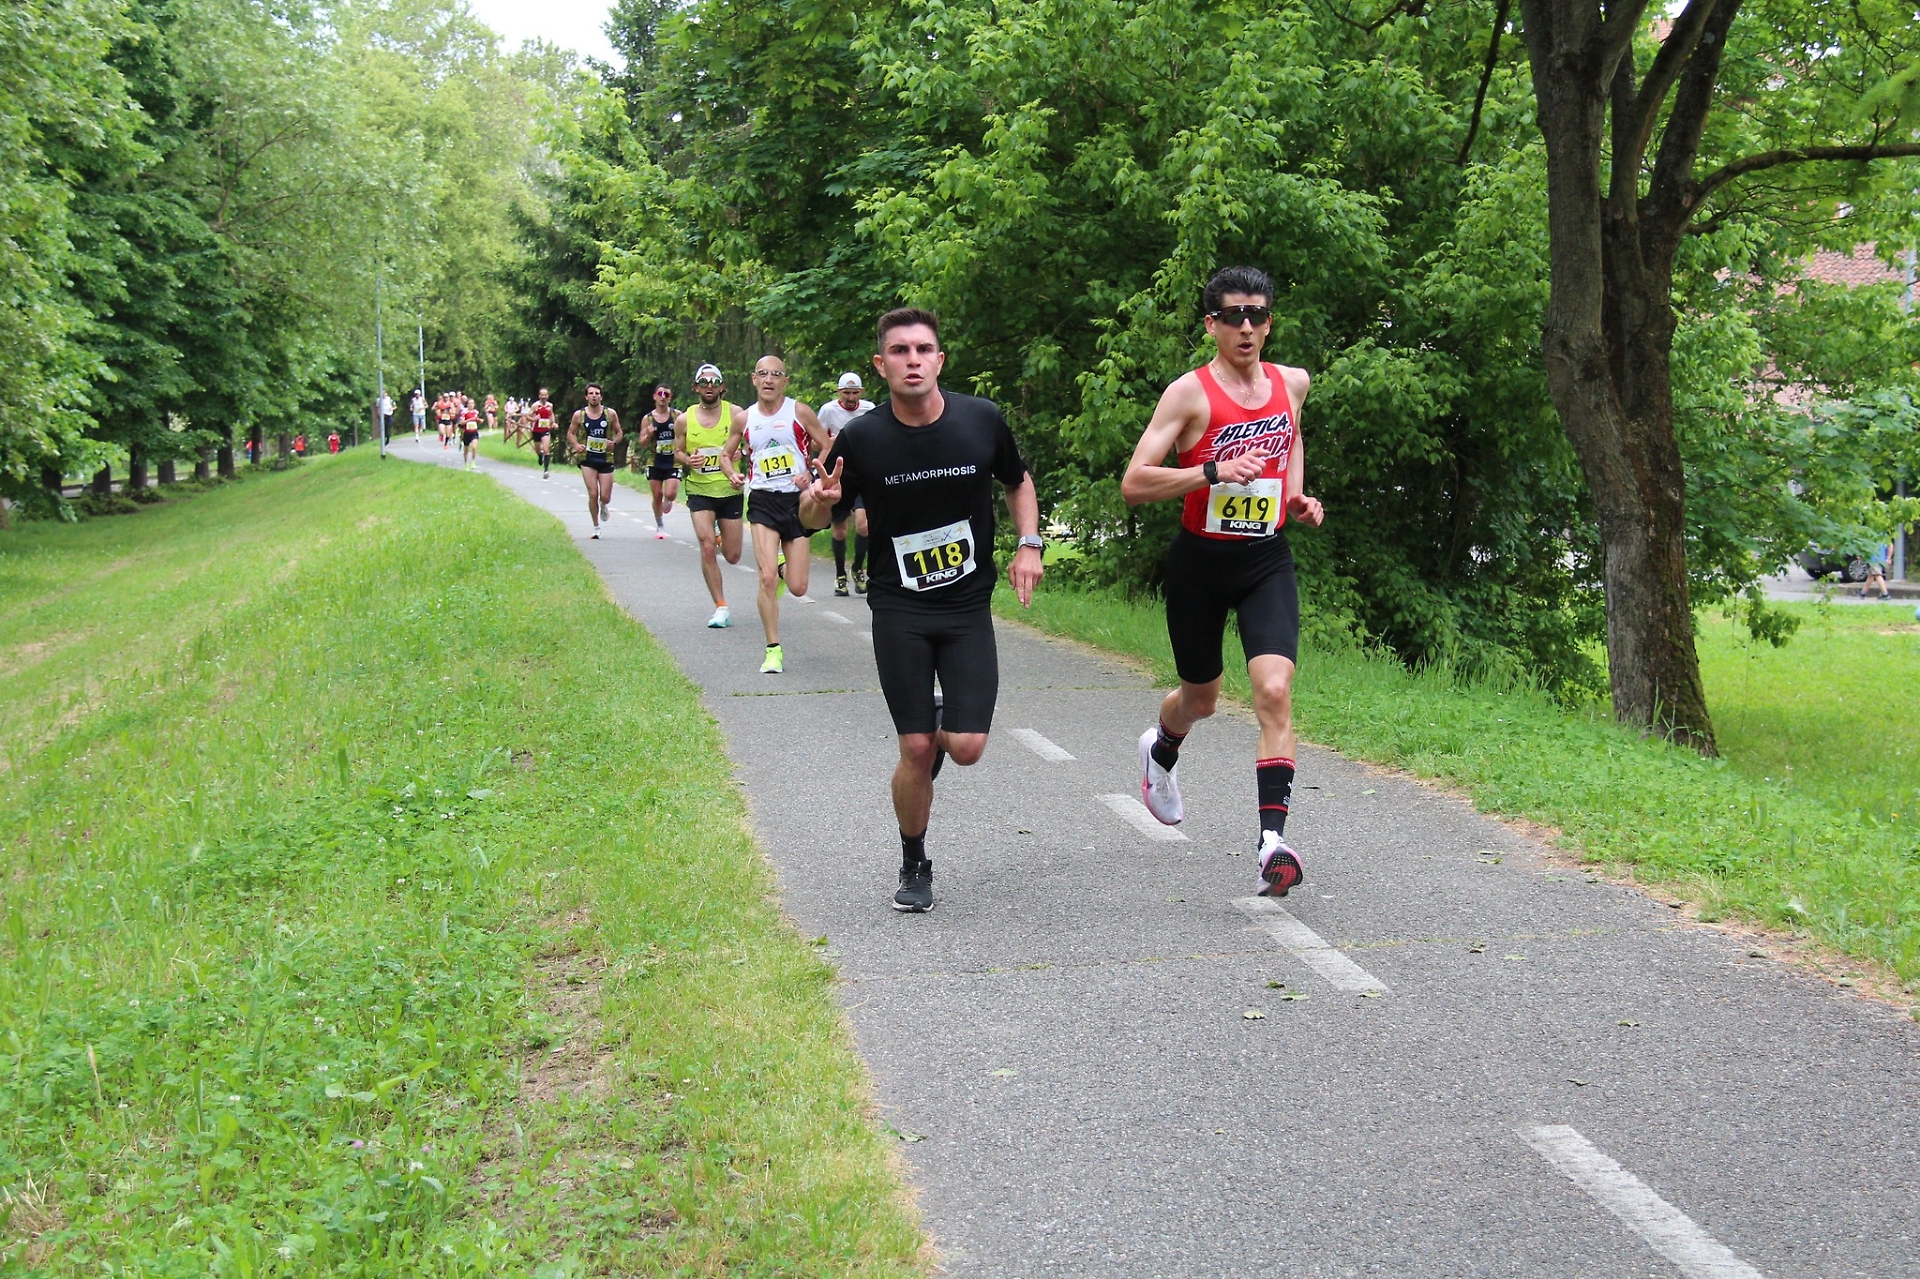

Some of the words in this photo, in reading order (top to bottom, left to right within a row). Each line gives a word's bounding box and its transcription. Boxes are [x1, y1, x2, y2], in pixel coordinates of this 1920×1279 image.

[1214, 414, 1289, 444] ATLETICA
[763, 455, 788, 471] 131
[885, 465, 976, 485] METAMORPHOSIS
[1223, 497, 1269, 521] 619
[1229, 521, 1261, 530] KING
[914, 543, 963, 574] 118
[926, 569, 958, 584] KING
